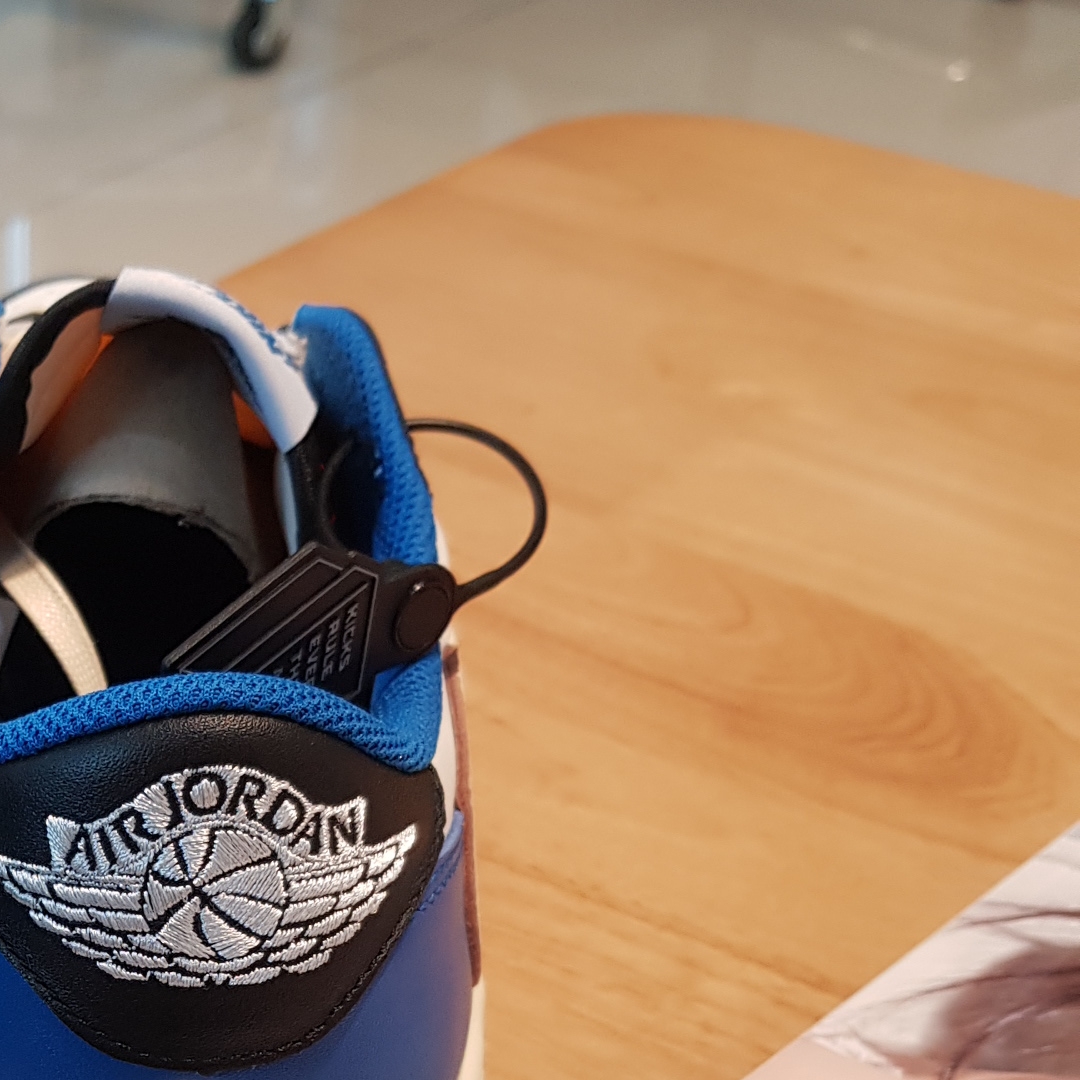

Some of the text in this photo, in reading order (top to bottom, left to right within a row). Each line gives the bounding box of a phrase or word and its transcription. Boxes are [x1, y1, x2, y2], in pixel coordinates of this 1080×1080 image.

[320, 618, 341, 681] RULE
[338, 603, 360, 672] KICKS
[66, 770, 360, 872] AIR JORDAN
